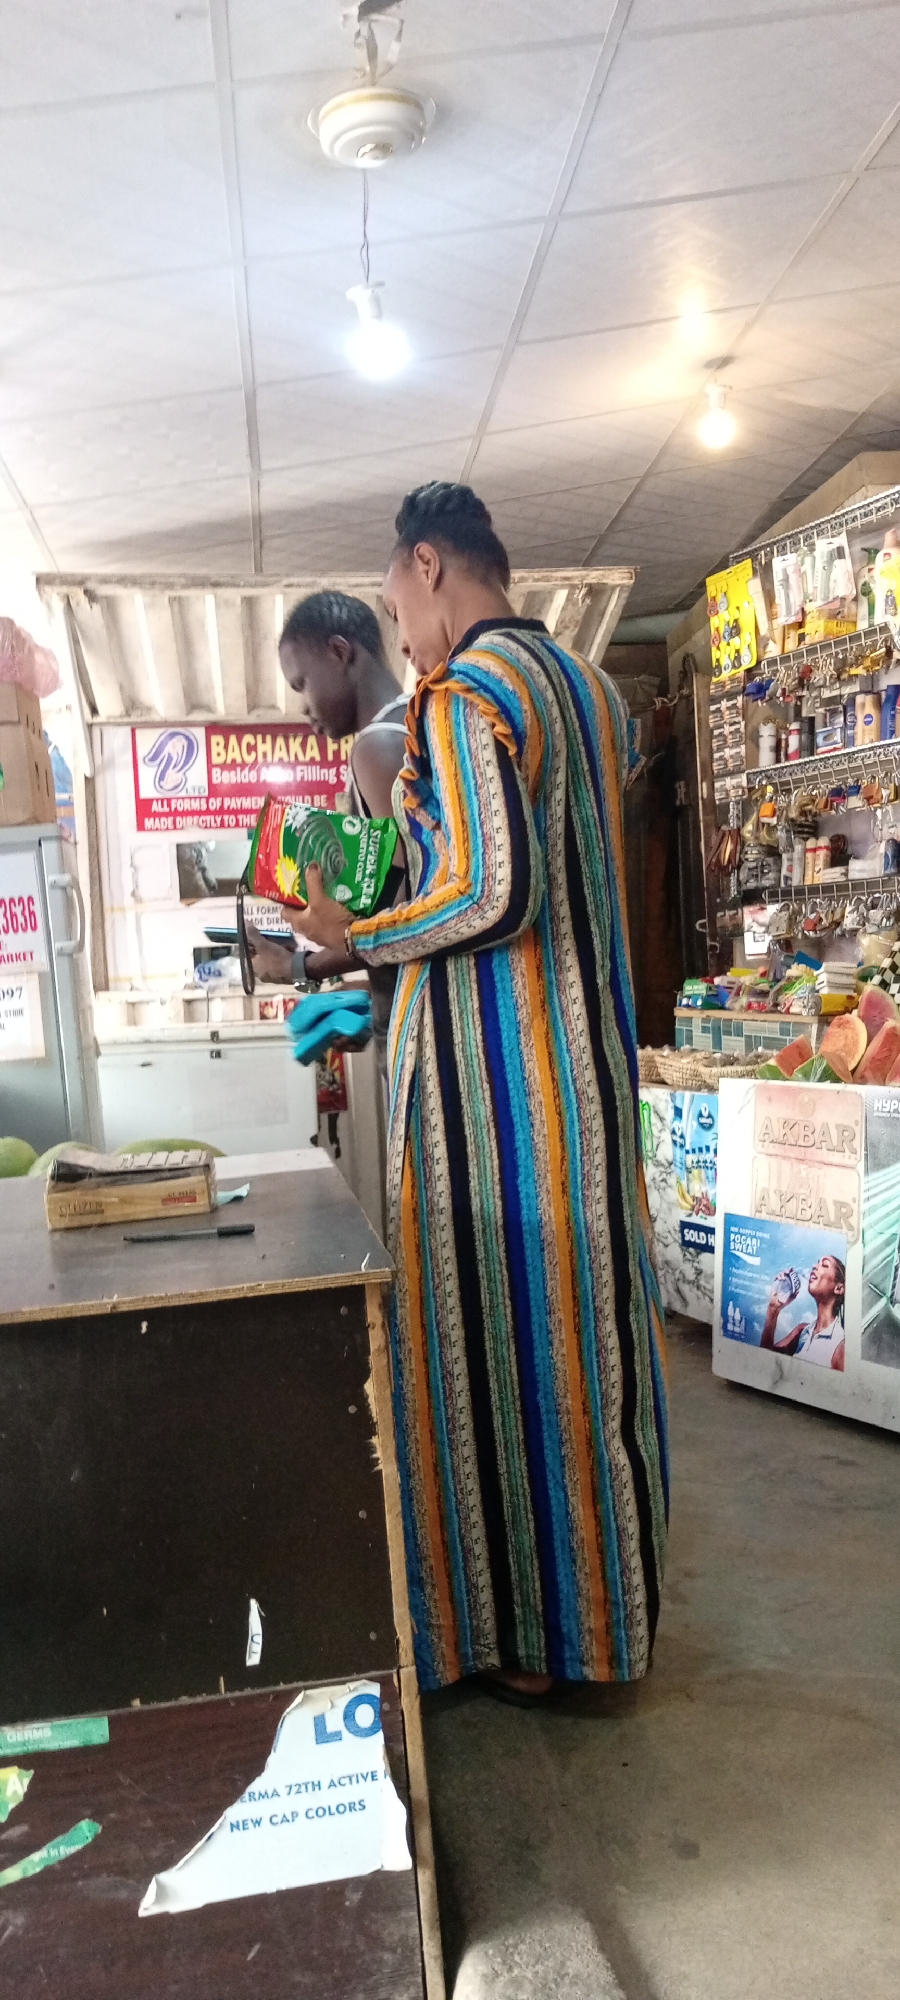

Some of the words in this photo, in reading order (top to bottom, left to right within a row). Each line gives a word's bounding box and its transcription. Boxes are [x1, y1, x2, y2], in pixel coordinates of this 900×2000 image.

[211, 733, 321, 764] BACHAKA
[211, 766, 257, 784] Beside
[296, 764, 337, 784] Filling
[185, 786, 206, 795] LTD
[152, 799, 170, 813] ALL
[171, 797, 208, 812] FORMS
[208, 797, 222, 811] OF
[223, 796, 265, 810] PAYMEN
[313, 794, 328, 807] BE
[144, 817, 174, 831] MADE
[222, 814, 236, 828] TO
[237, 813, 258, 828] THE
[256, 905, 282, 916] FORM
[757, 1116, 857, 1155] AKBAR
[754, 1187, 855, 1232] AKBAR
[683, 1229, 707, 1245] SOLD
[729, 1233, 760, 1248] POCARI
[729, 1241, 757, 1255] SWEAT
[285, 1780, 322, 1797] 72TH
[327, 1770, 379, 1790] ACTIVE
[229, 1817, 263, 1833] NEW
[269, 1811, 299, 1827] CAP
[305, 1799, 367, 1820] COLORS
